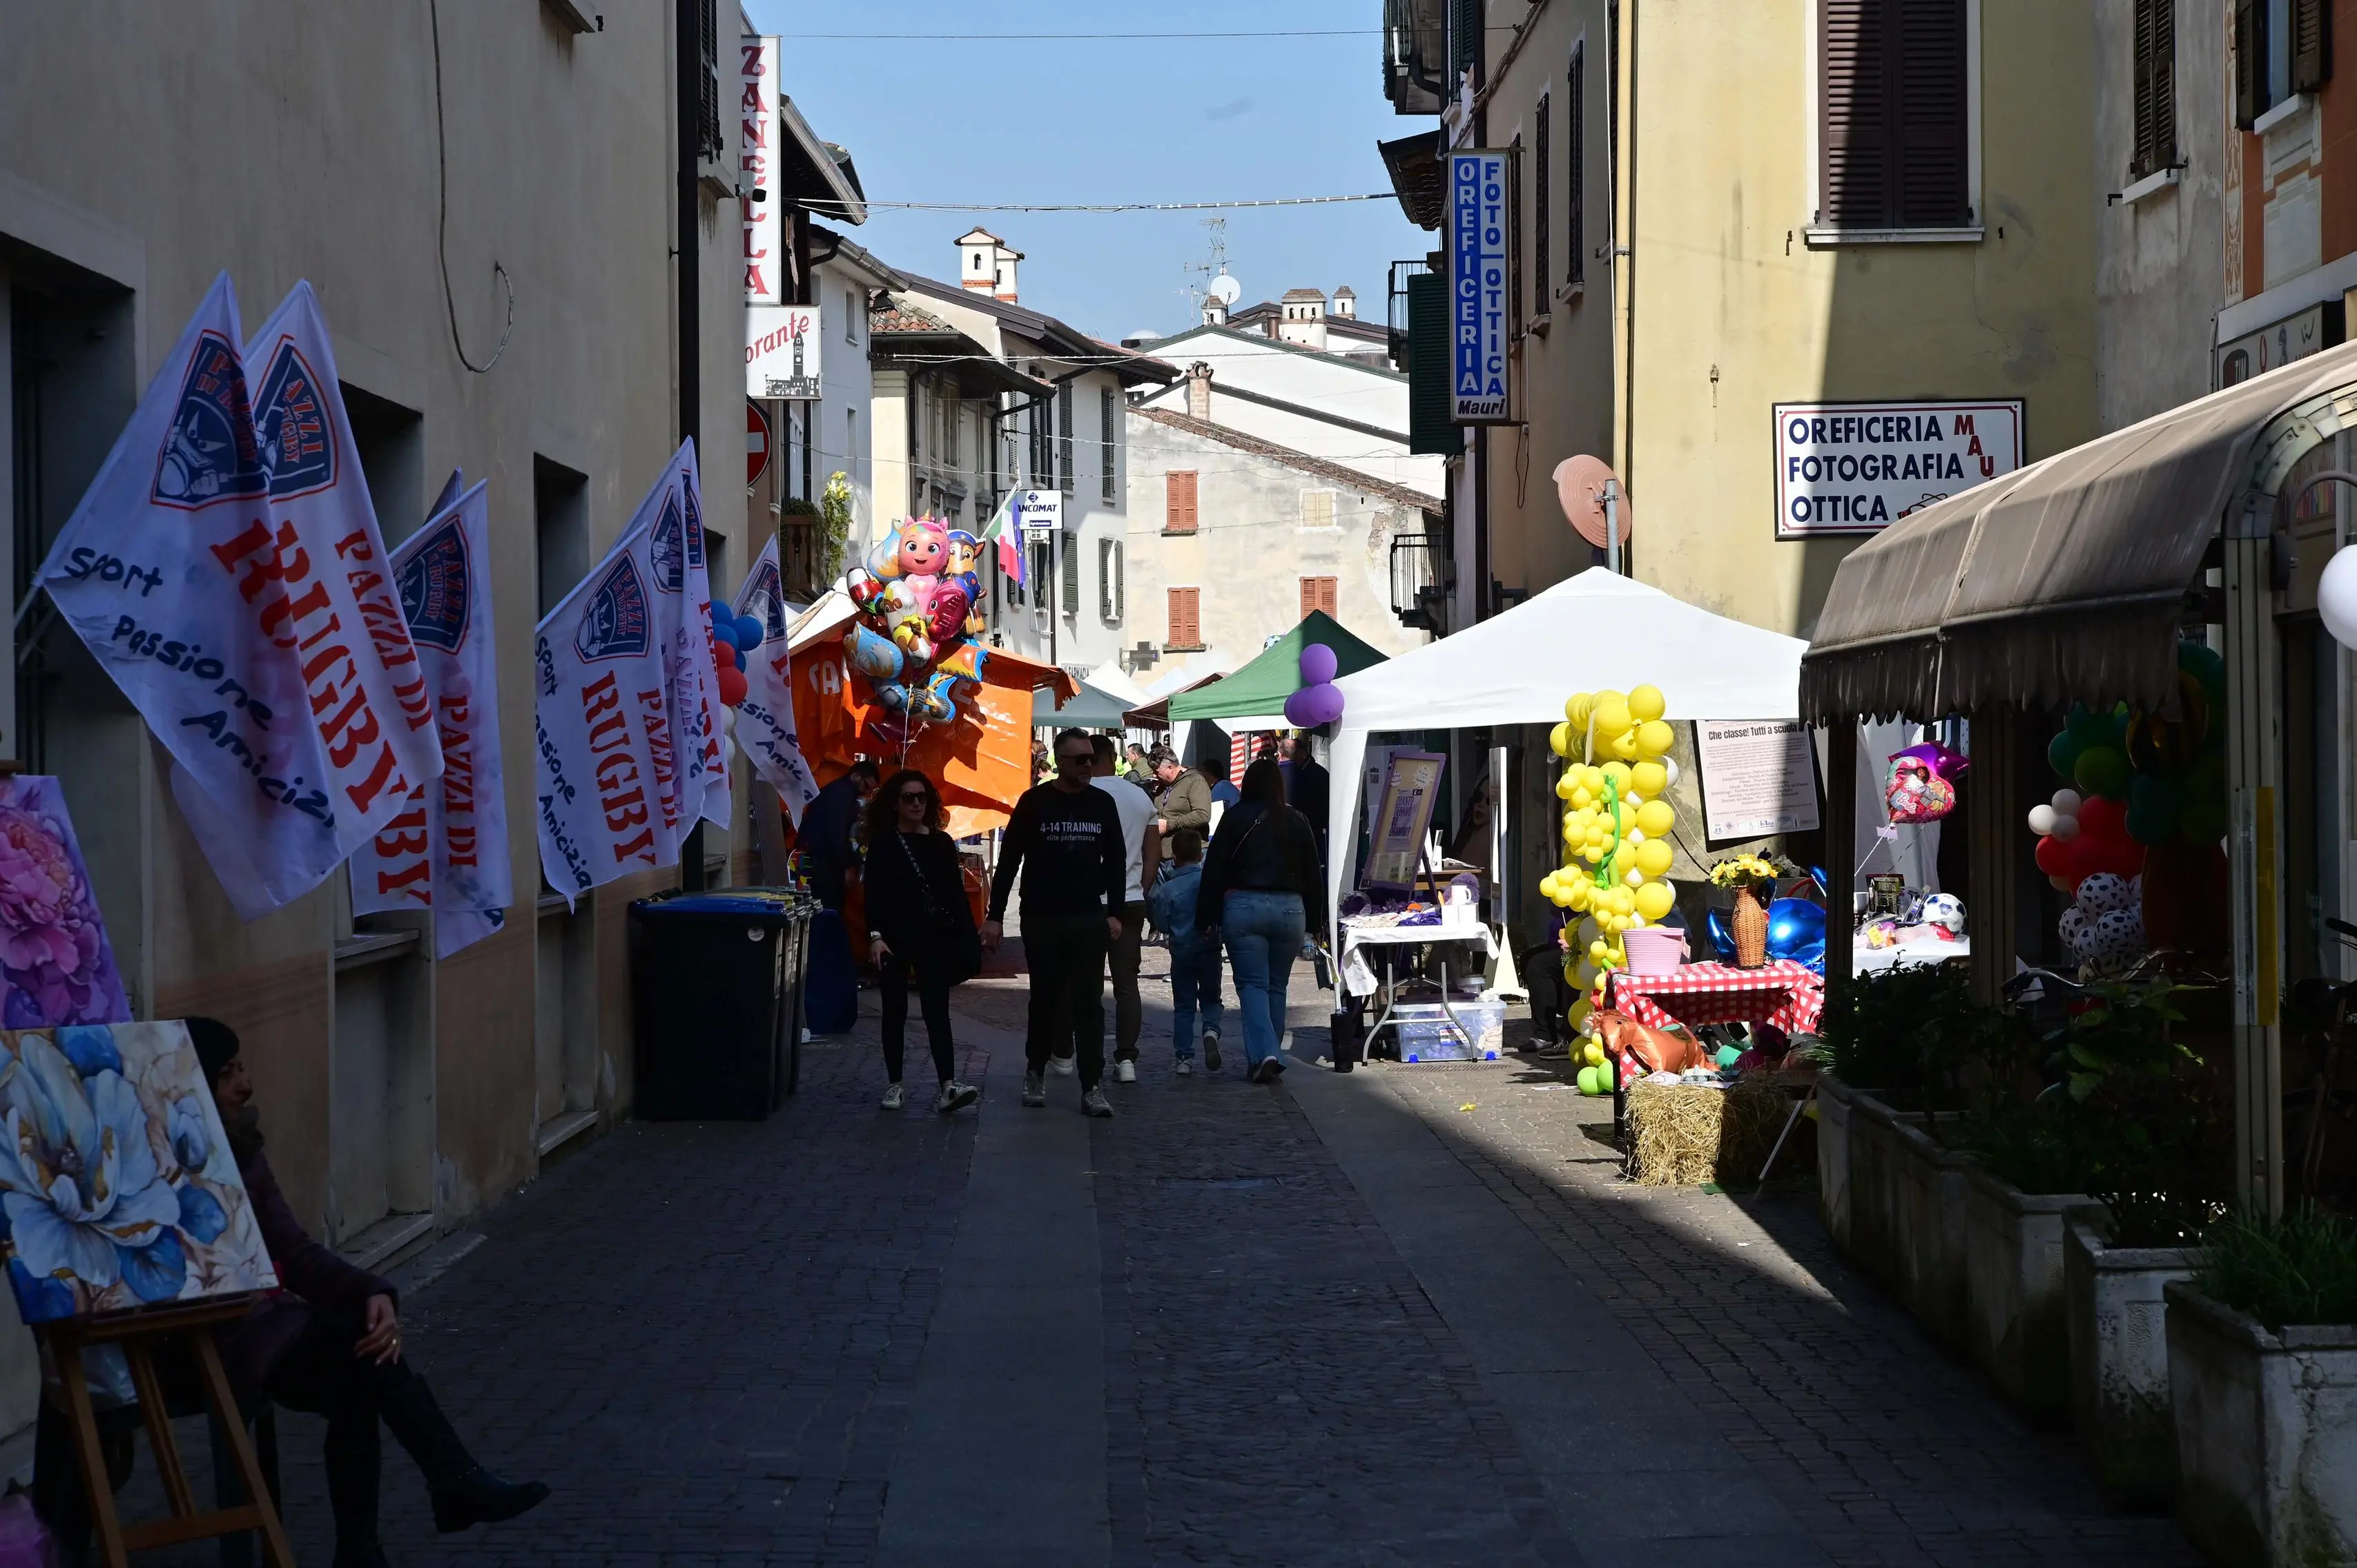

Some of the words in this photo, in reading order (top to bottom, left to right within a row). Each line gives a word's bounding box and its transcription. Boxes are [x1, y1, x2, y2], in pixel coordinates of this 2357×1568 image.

[741, 46, 769, 295] ZANELLA
[1485, 162, 1501, 246] FOTO
[1459, 162, 1479, 392] OREFICERIA
[746, 311, 809, 364] orante
[1485, 269, 1505, 396] OTTICA
[282, 378, 323, 456] AZZI
[1458, 398, 1505, 415] Mauri
[1789, 415, 1943, 444] OREFICERIA
[1789, 452, 1964, 482] FOTOGRAFIA
[1955, 414, 1996, 481] MAU
[1017, 504, 1058, 512] ANCOMAT
[1792, 494, 1889, 523] OTTICA
[64, 547, 164, 597] Sport
[622, 568, 643, 634] PAZZI
[335, 528, 418, 672] PAZZI
[393, 674, 433, 732] DI
[112, 614, 273, 732] Passione
[438, 693, 474, 813] PAZZI
[737, 699, 799, 749] ssione
[1708, 730, 1722, 741] Che
[1723, 728, 1749, 739] classe!
[1751, 726, 1766, 736] Tutti
[1768, 726, 1772, 735] a
[1774, 724, 1798, 734] scuola
[180, 710, 336, 829] Amicizi
[535, 711, 576, 806] assione
[581, 669, 657, 866] RUGBY
[447, 826, 478, 867] DI
[538, 794, 594, 890] Amicizia
[1040, 822, 1060, 833] 4-14
[1061, 822, 1102, 833] TRAINING
